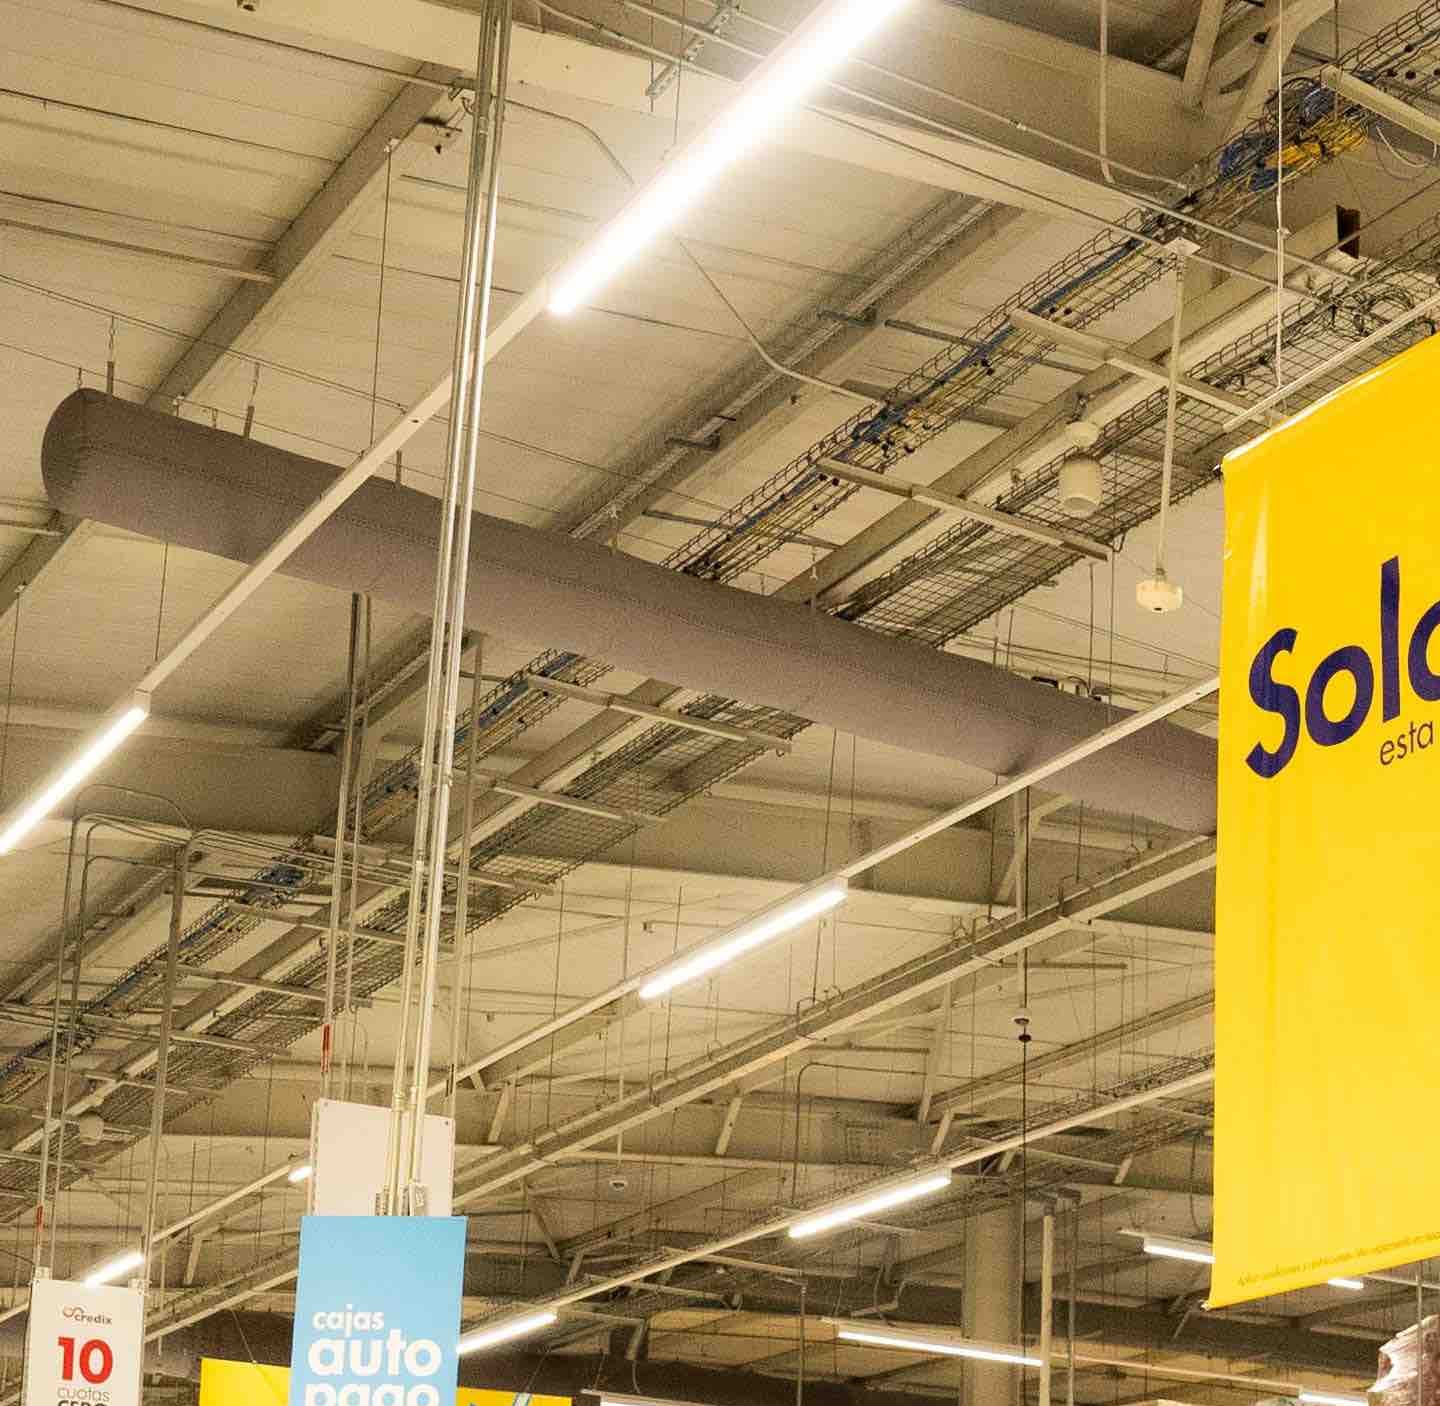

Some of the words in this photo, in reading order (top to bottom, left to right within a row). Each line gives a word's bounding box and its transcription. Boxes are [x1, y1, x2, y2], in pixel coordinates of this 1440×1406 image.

[1380, 718, 1434, 765] esta
[75, 1313, 112, 1325] credix
[312, 1303, 384, 1337] cajas
[58, 1337, 113, 1384] 10
[308, 1329, 441, 1377] auto
[57, 1387, 110, 1401] cuotas
